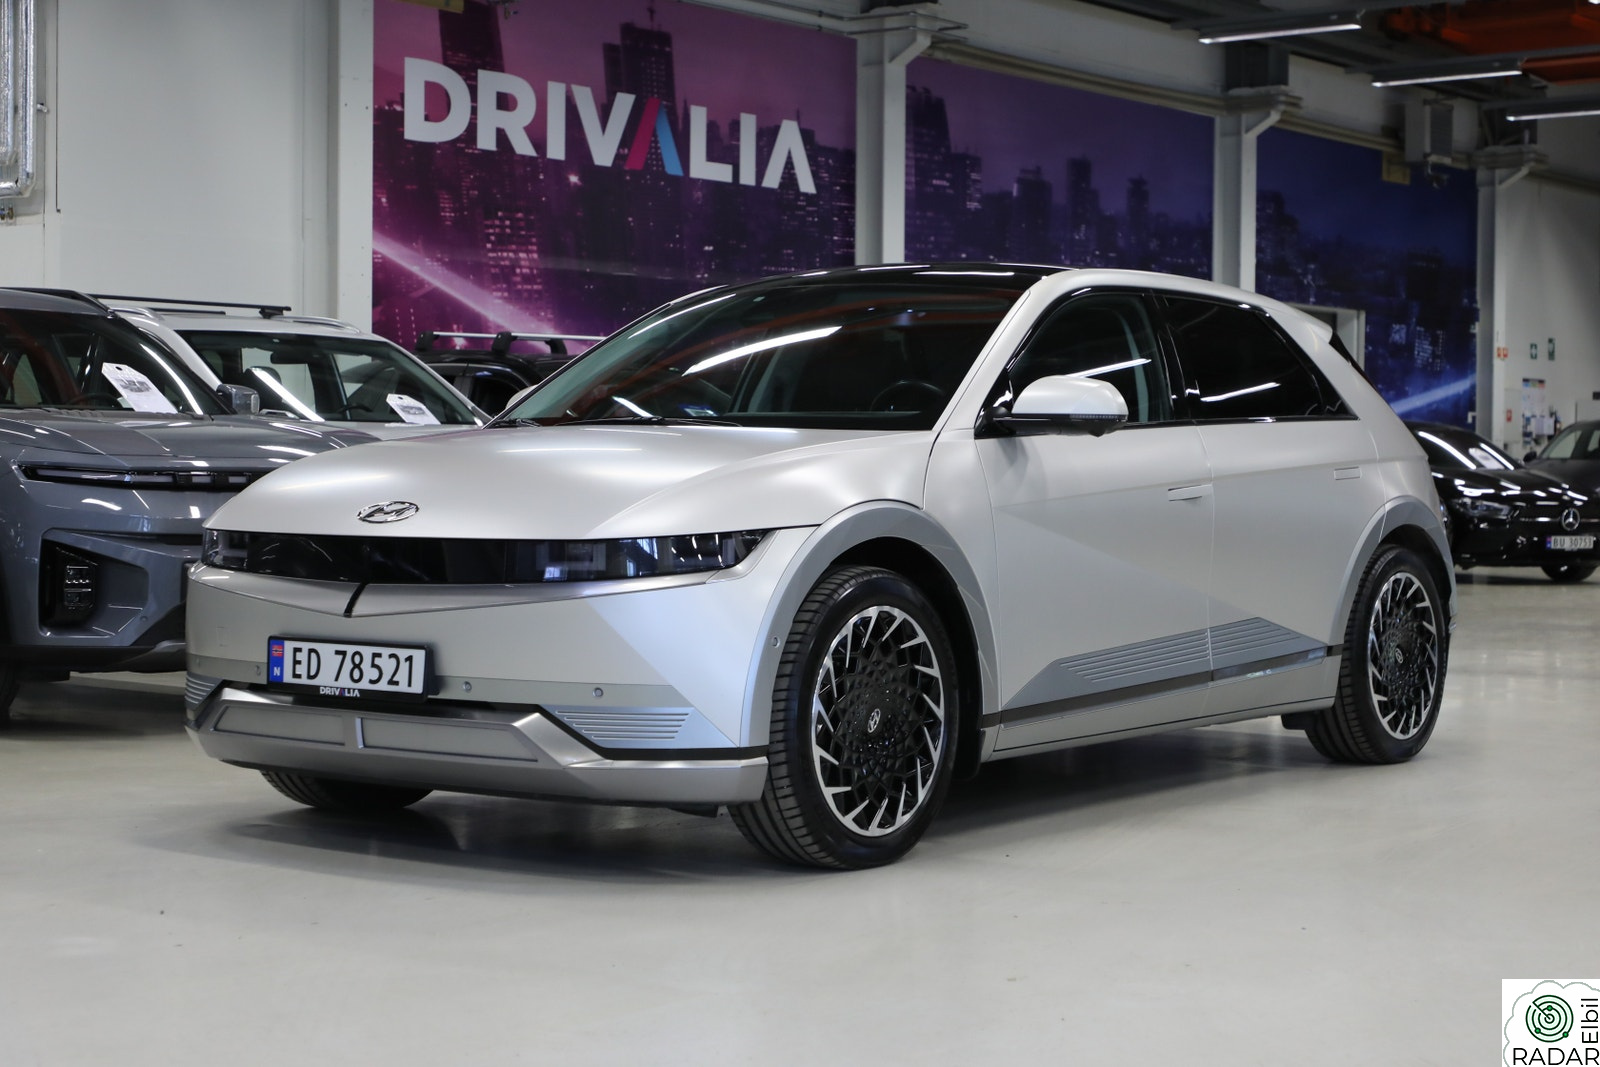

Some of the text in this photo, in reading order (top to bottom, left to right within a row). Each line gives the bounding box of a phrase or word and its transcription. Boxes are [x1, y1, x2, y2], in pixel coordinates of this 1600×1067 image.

[404, 56, 817, 194] DRIVALIA
[273, 666, 281, 676] N
[292, 647, 414, 687] ED 78521
[319, 686, 360, 697] DRIVALIA
